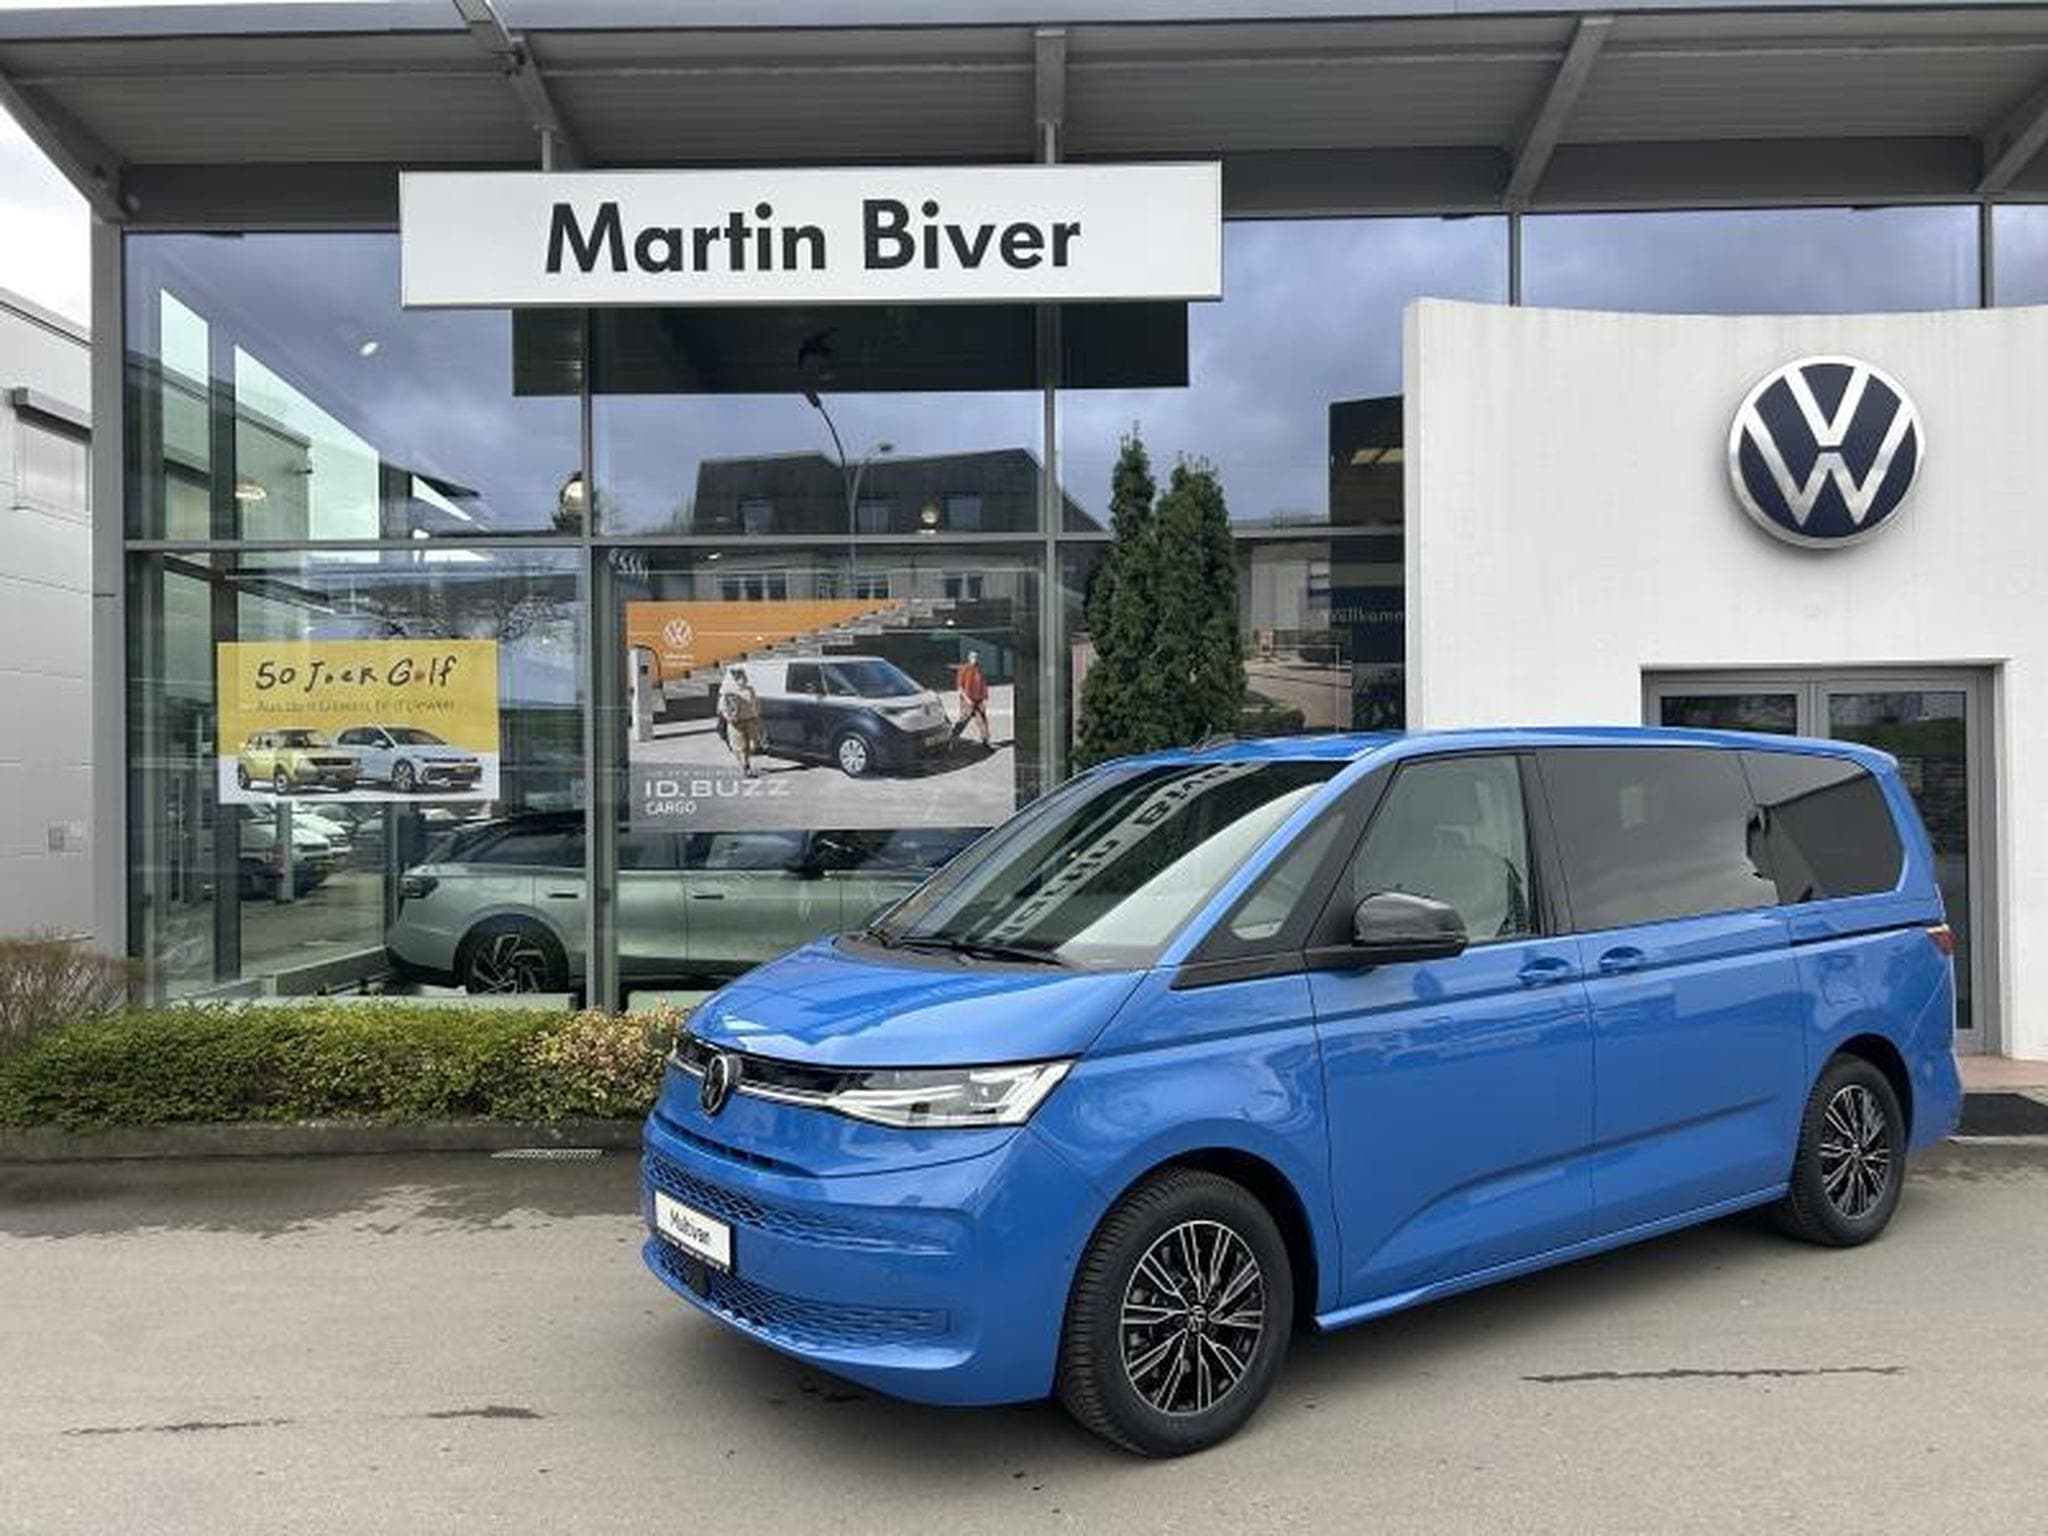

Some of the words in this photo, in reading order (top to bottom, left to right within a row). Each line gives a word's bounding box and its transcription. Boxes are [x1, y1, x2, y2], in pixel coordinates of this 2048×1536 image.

[544, 201, 827, 273] Martin
[862, 199, 1081, 270] Biver
[255, 661, 296, 690] 50
[645, 800, 697, 816] CARGO
